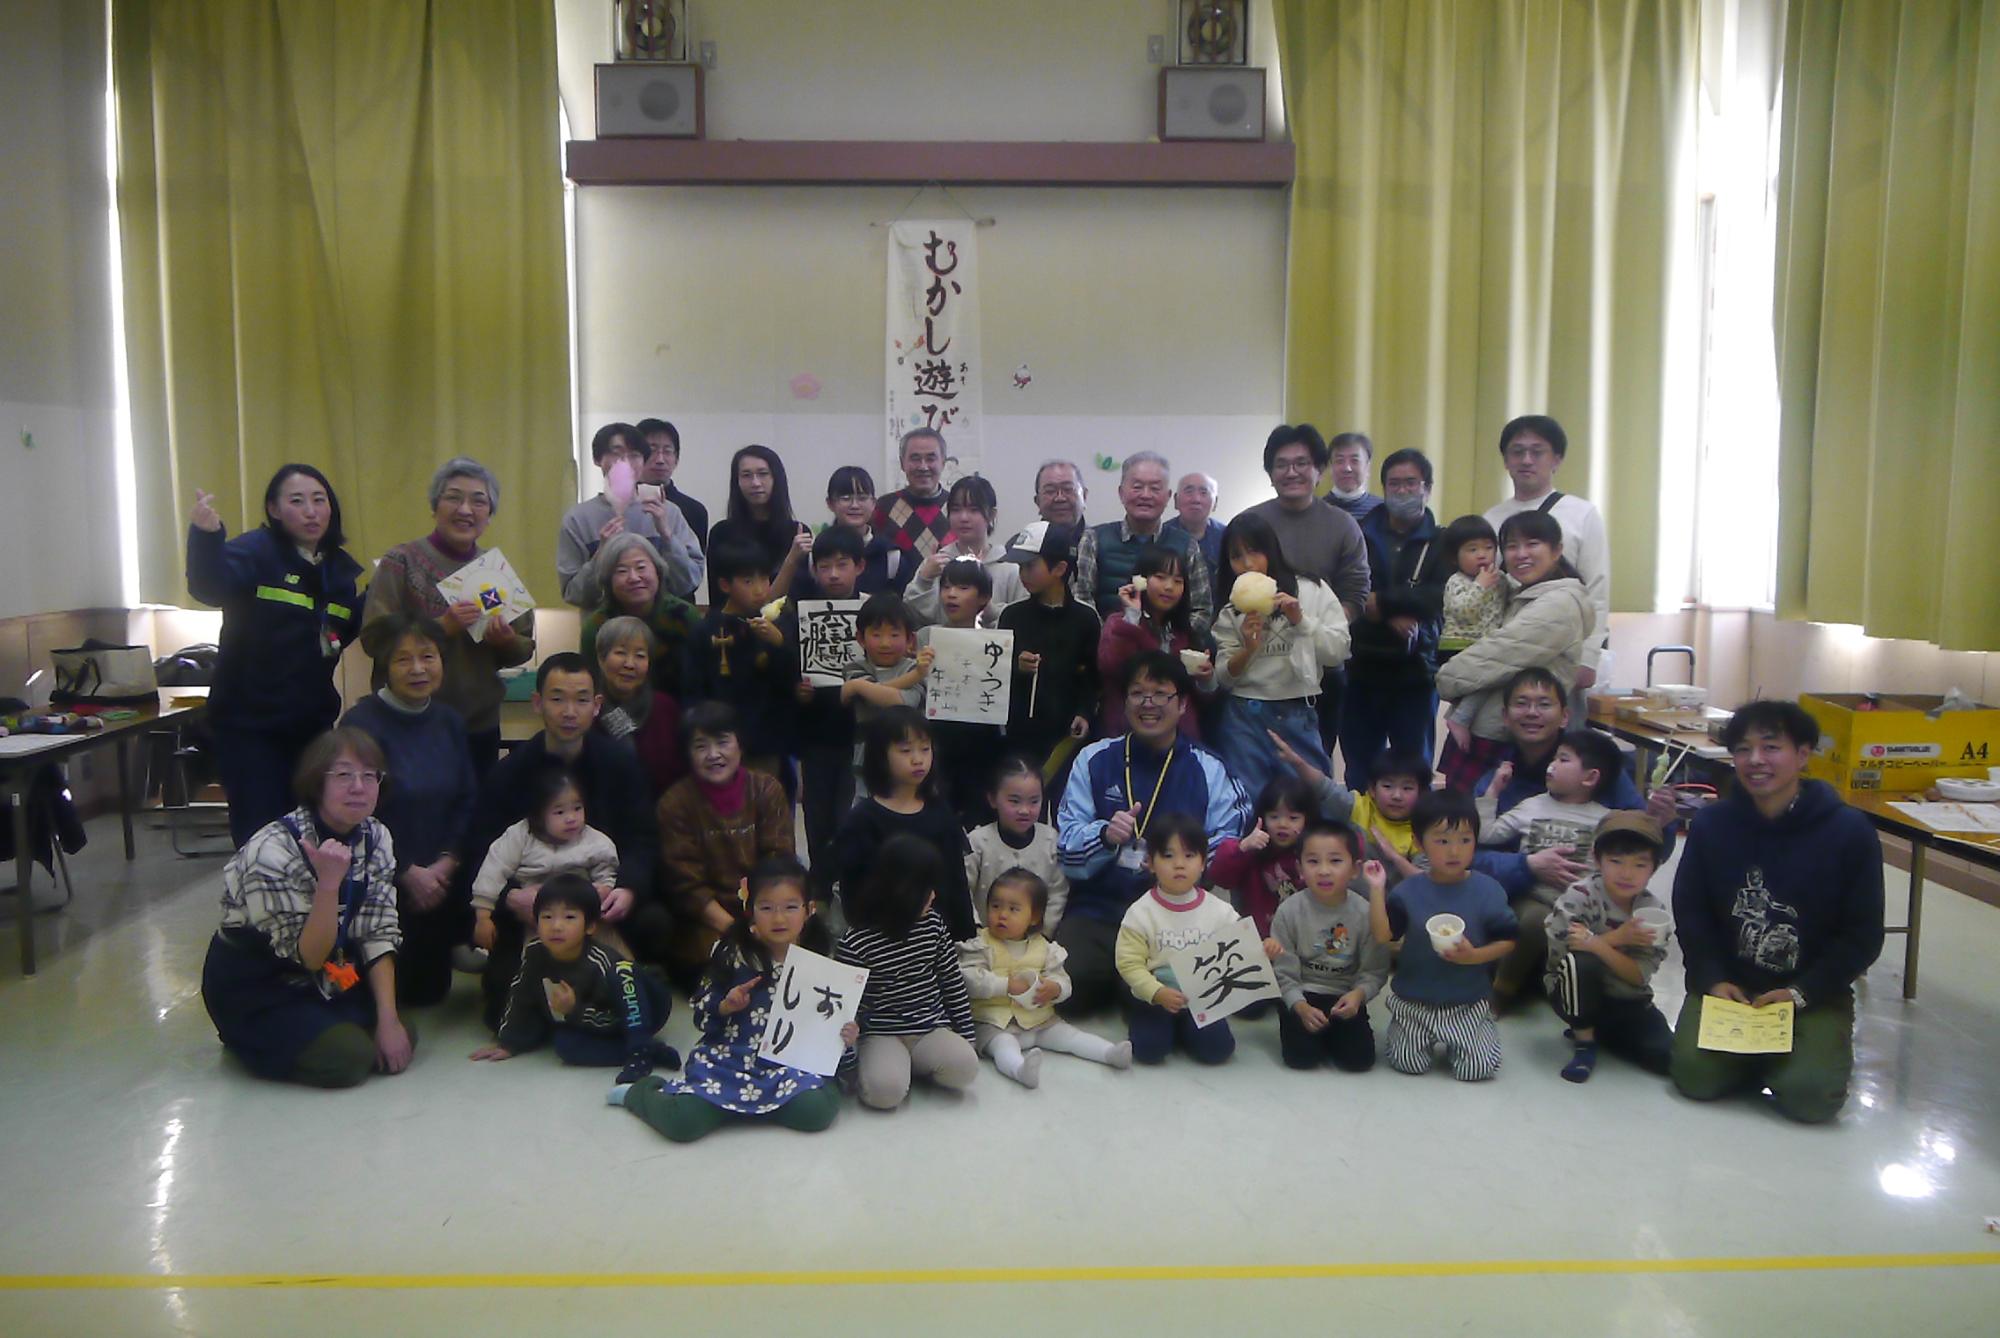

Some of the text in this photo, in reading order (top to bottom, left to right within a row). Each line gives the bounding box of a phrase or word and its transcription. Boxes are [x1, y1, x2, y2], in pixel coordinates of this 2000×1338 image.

[978, 641, 1003, 712] ゆうき
[1959, 741, 1988, 760] A4
[620, 973, 642, 1029] Hurley
[1193, 938, 1271, 1010] 笑
